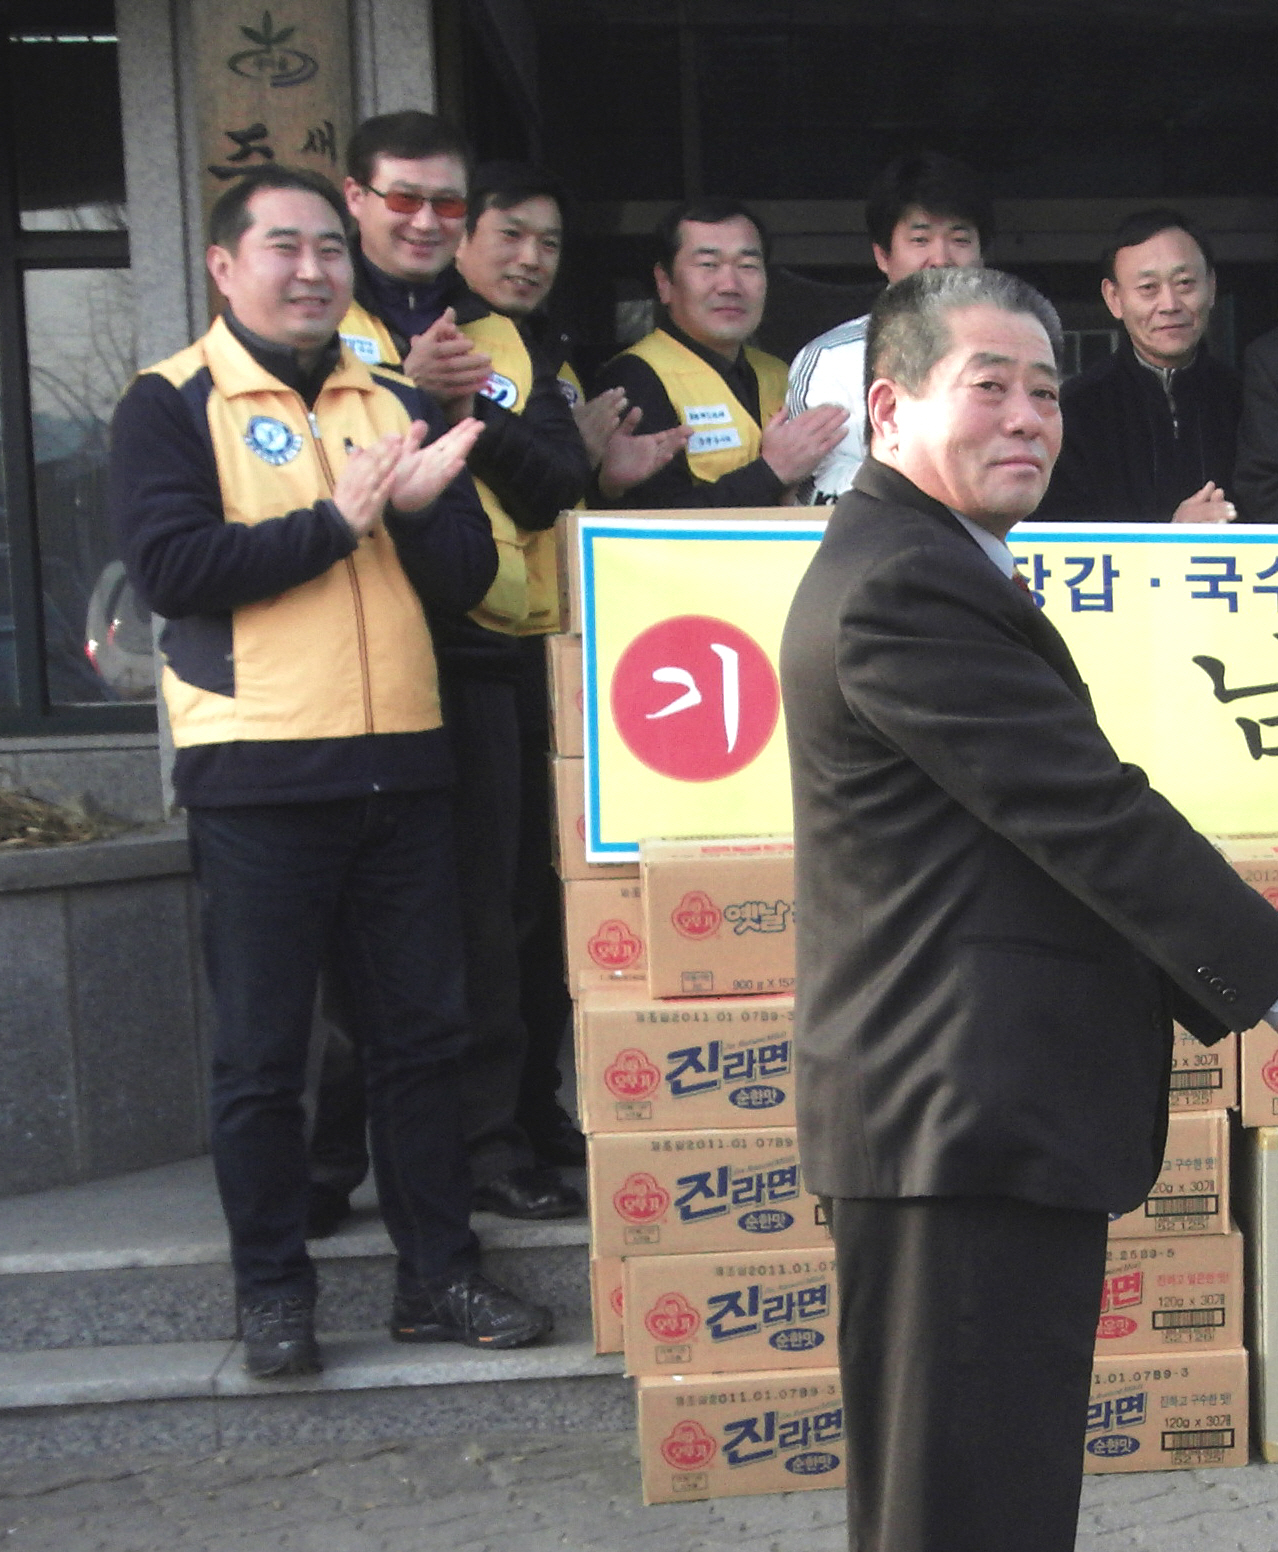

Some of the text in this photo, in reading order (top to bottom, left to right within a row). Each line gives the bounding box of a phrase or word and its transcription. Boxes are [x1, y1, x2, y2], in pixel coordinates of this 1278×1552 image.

[645, 642, 740, 754] 기
[664, 1039, 793, 1100] 진라면
[674, 1163, 800, 1225] 진라면
[705, 1282, 830, 1344] 진라면
[721, 1406, 844, 1470] 진라면
